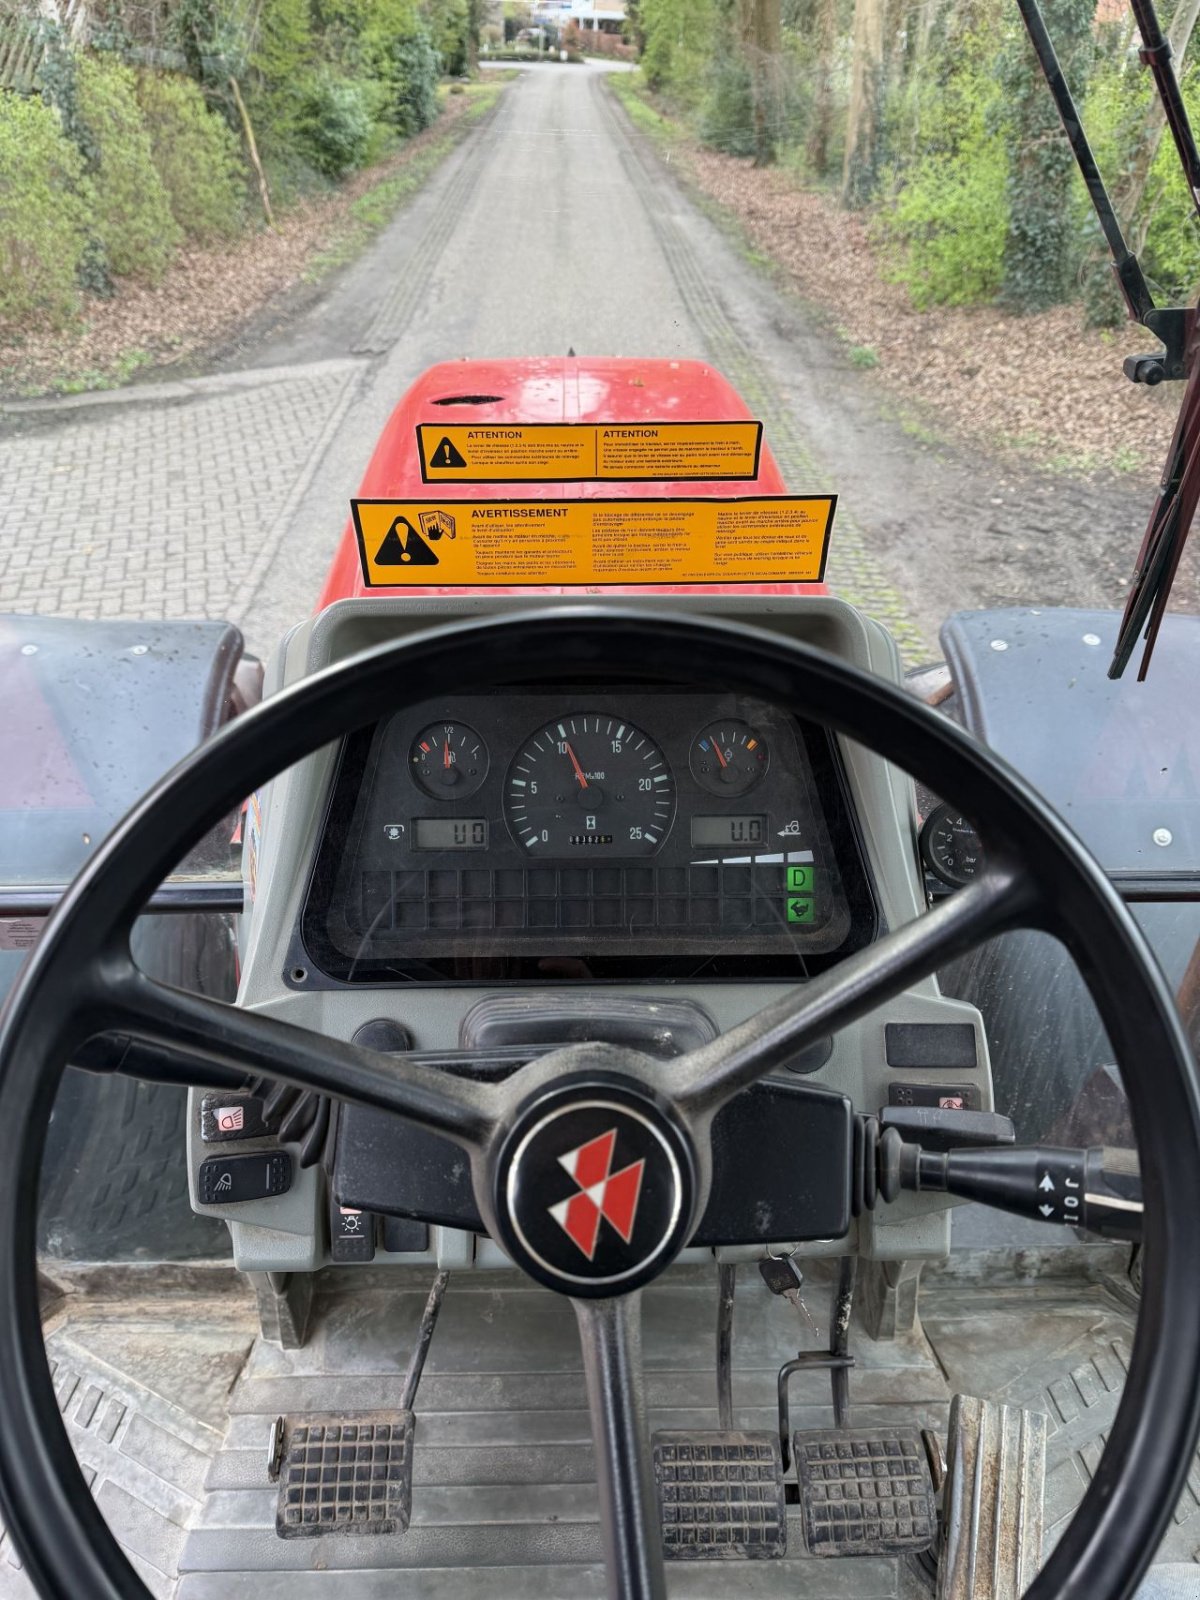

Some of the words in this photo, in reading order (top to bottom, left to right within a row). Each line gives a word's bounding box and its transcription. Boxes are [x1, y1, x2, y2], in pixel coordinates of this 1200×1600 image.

[467, 431, 523, 439] ATTENTION
[603, 430, 659, 438] ATTENTION
[471, 508, 569, 518] AVERTISSEMENT
[444, 726, 454, 734] 1/2
[557, 741, 568, 754] 10
[611, 741, 622, 753] 15
[421, 753, 426, 761] 0
[473, 753, 477, 761] 1
[530, 781, 538, 795] 5
[638, 779, 652, 791] 20
[956, 817, 963, 825] 4
[541, 829, 549, 842] 0
[629, 826, 642, 840] 25
[946, 834, 953, 843] 2
[947, 858, 954, 866] 0
[793, 869, 806, 887] D
